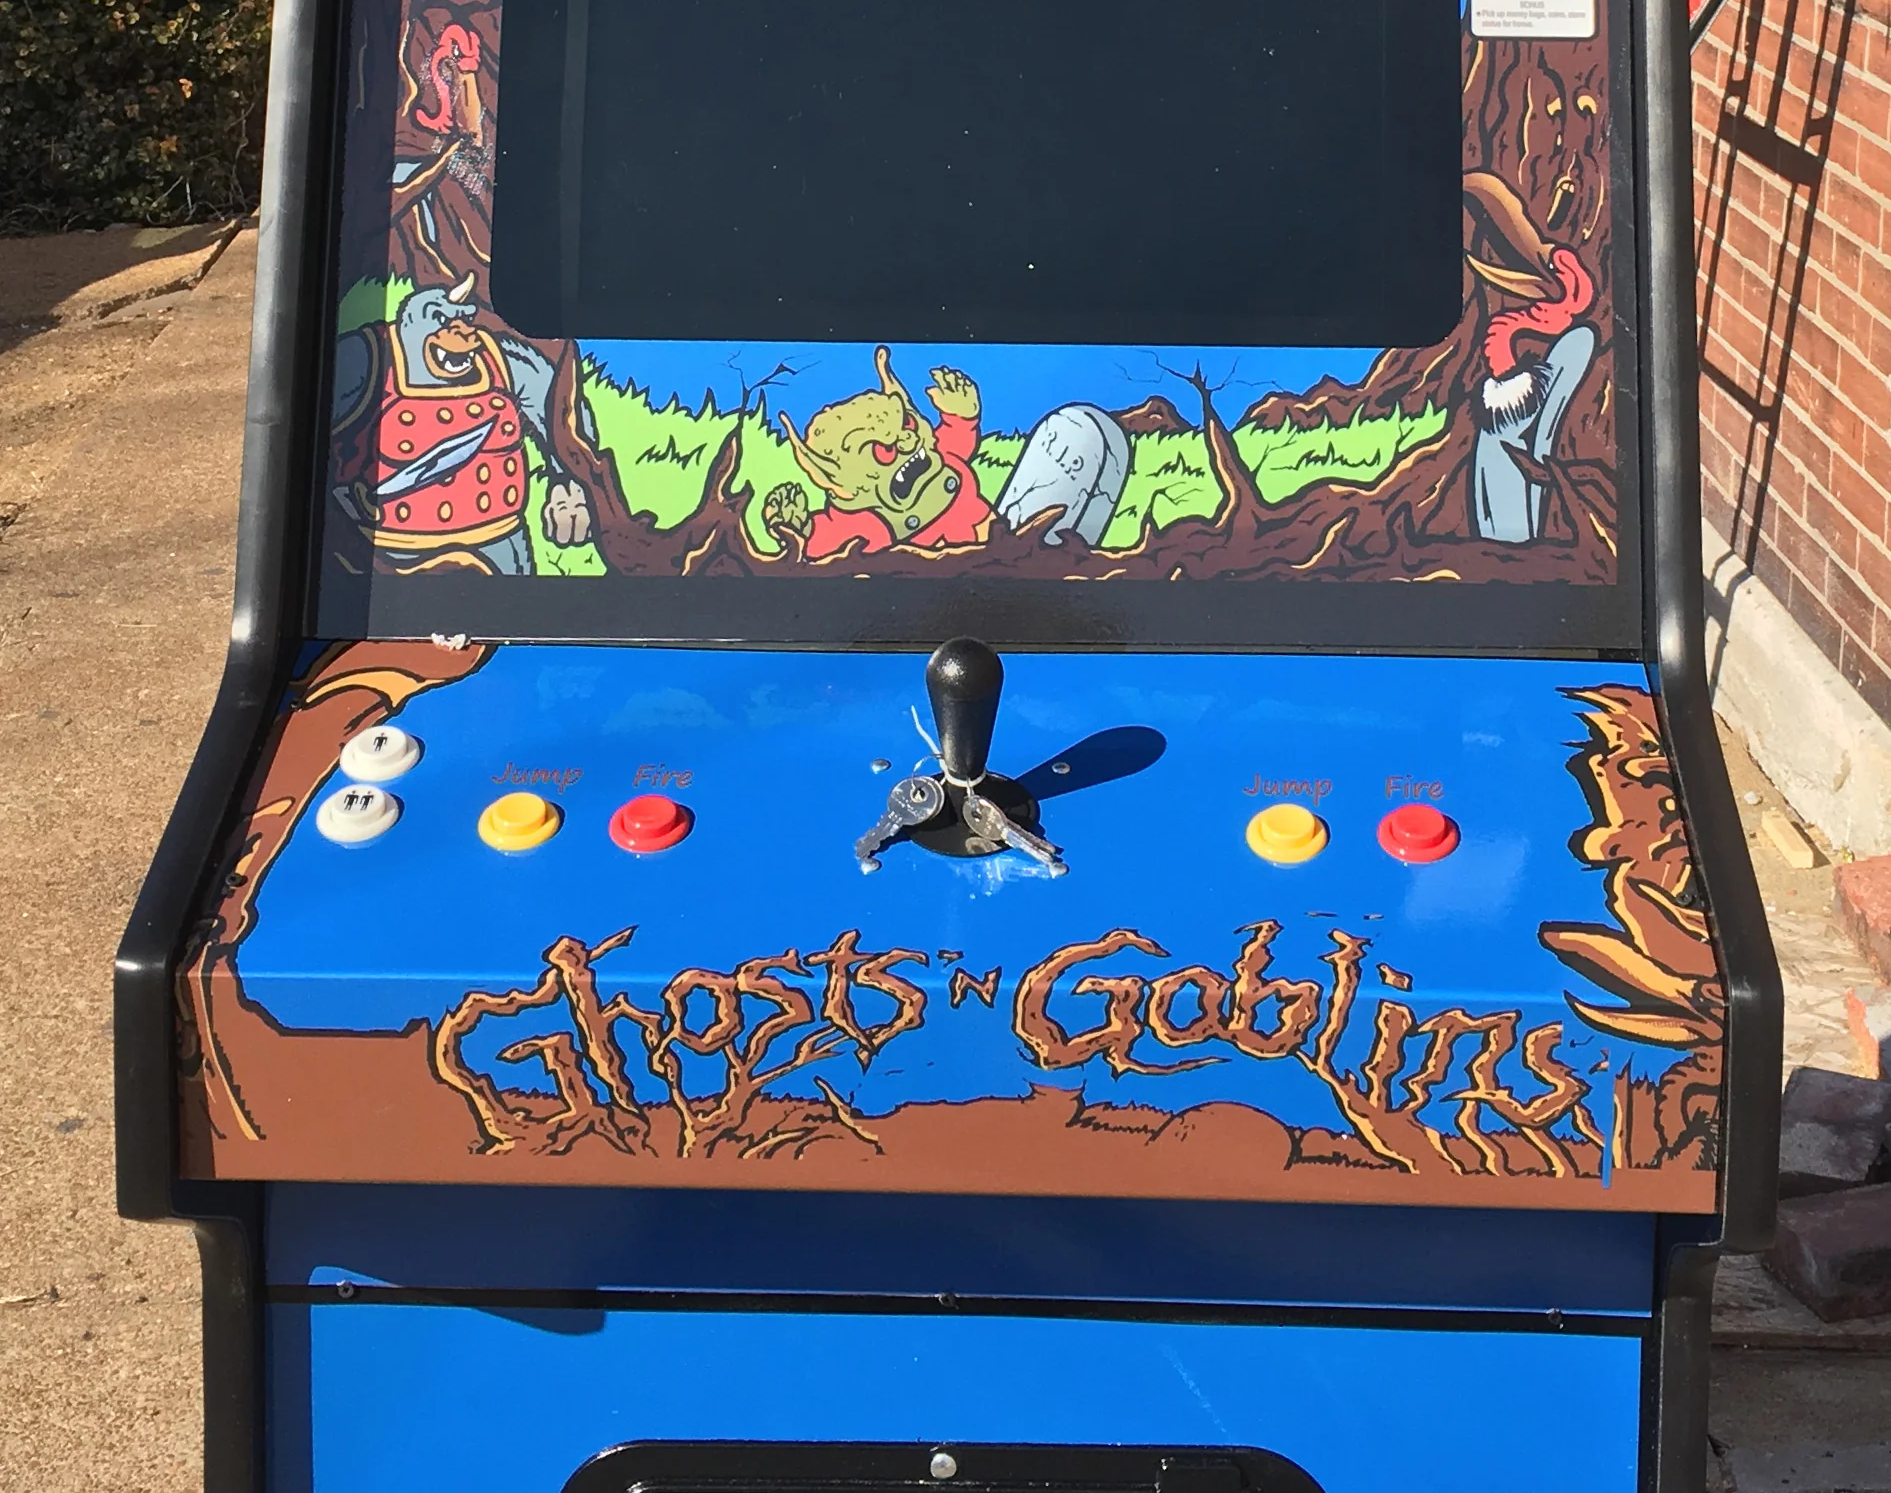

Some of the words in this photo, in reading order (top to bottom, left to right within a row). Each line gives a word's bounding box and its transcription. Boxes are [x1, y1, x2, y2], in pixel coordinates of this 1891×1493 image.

[491, 761, 585, 794] Jump
[631, 763, 694, 789] Fire
[1243, 772, 1333, 805] Jump
[1384, 774, 1445, 801] Fire
[434, 924, 930, 1159] Ghosts
[1011, 917, 1604, 1177] Goblins
